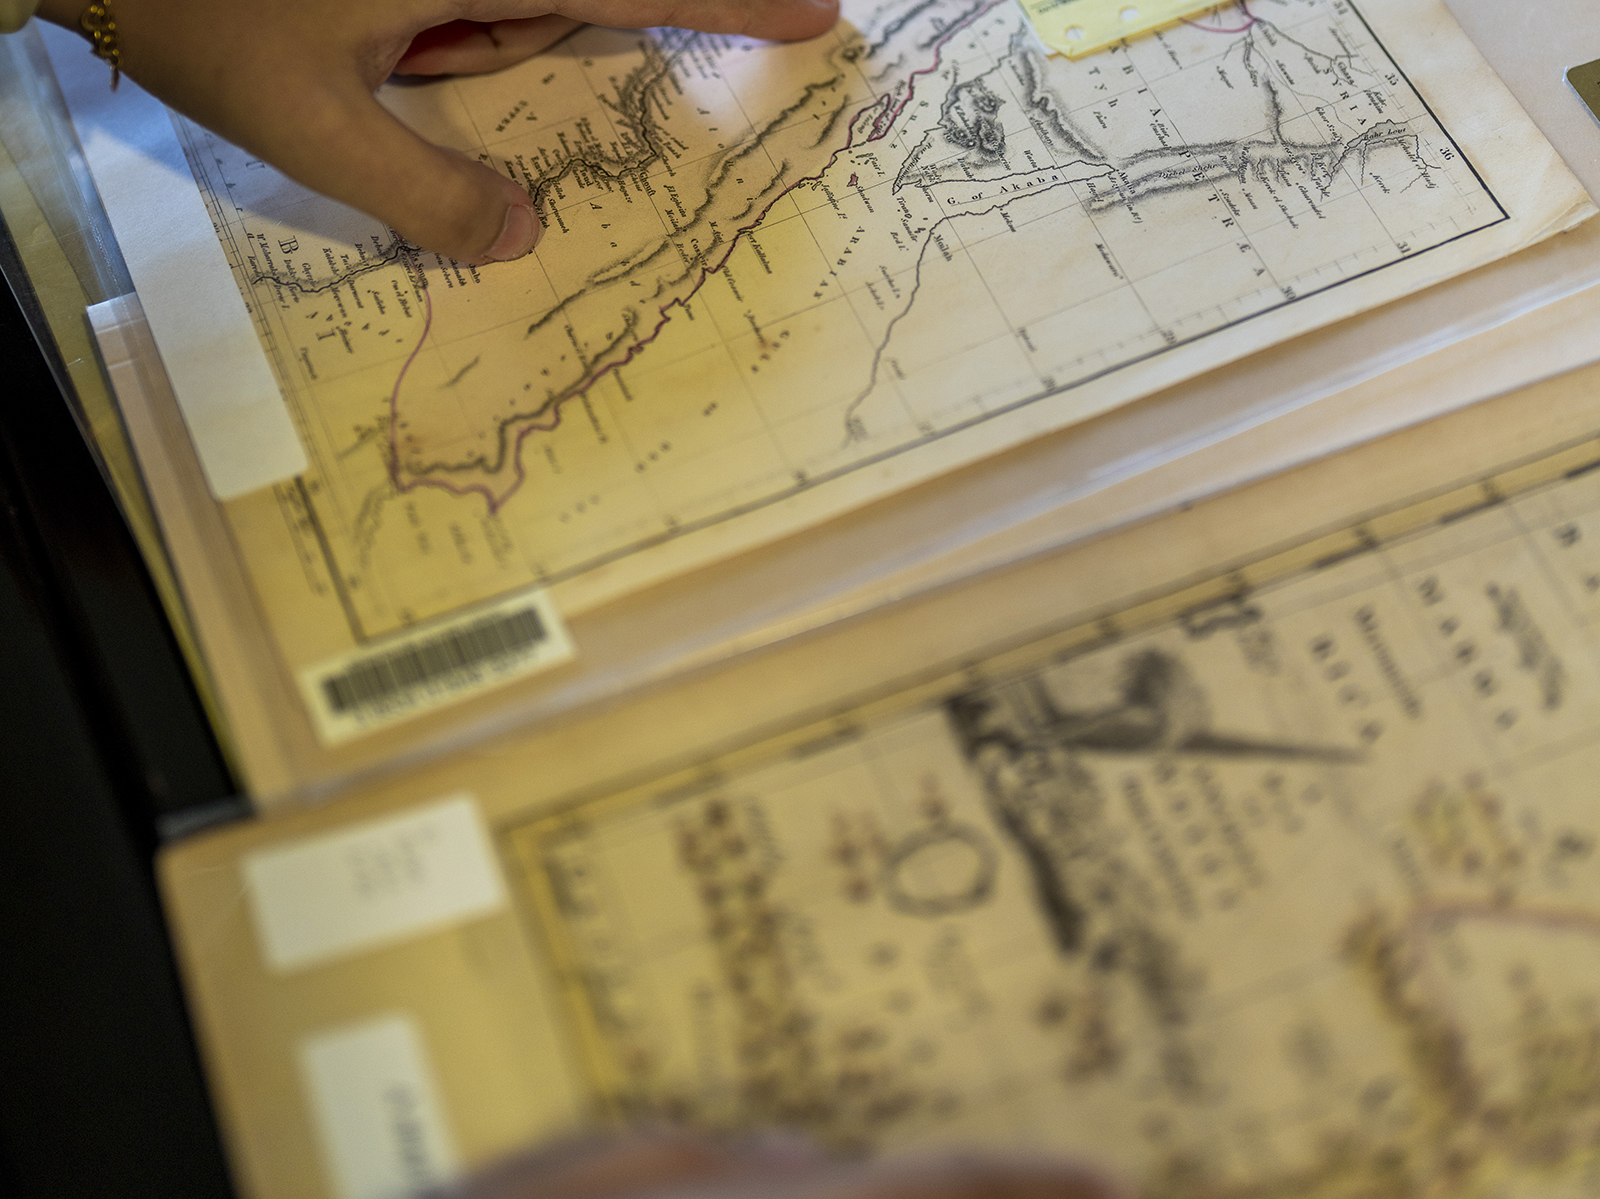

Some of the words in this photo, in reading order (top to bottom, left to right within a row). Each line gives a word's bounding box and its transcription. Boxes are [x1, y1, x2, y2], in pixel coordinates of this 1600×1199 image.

[1384, 70, 1399, 86] 35
[890, 99, 928, 150] Suez
[1440, 146, 1456, 161] 36
[999, 173, 1060, 194] Akaba
